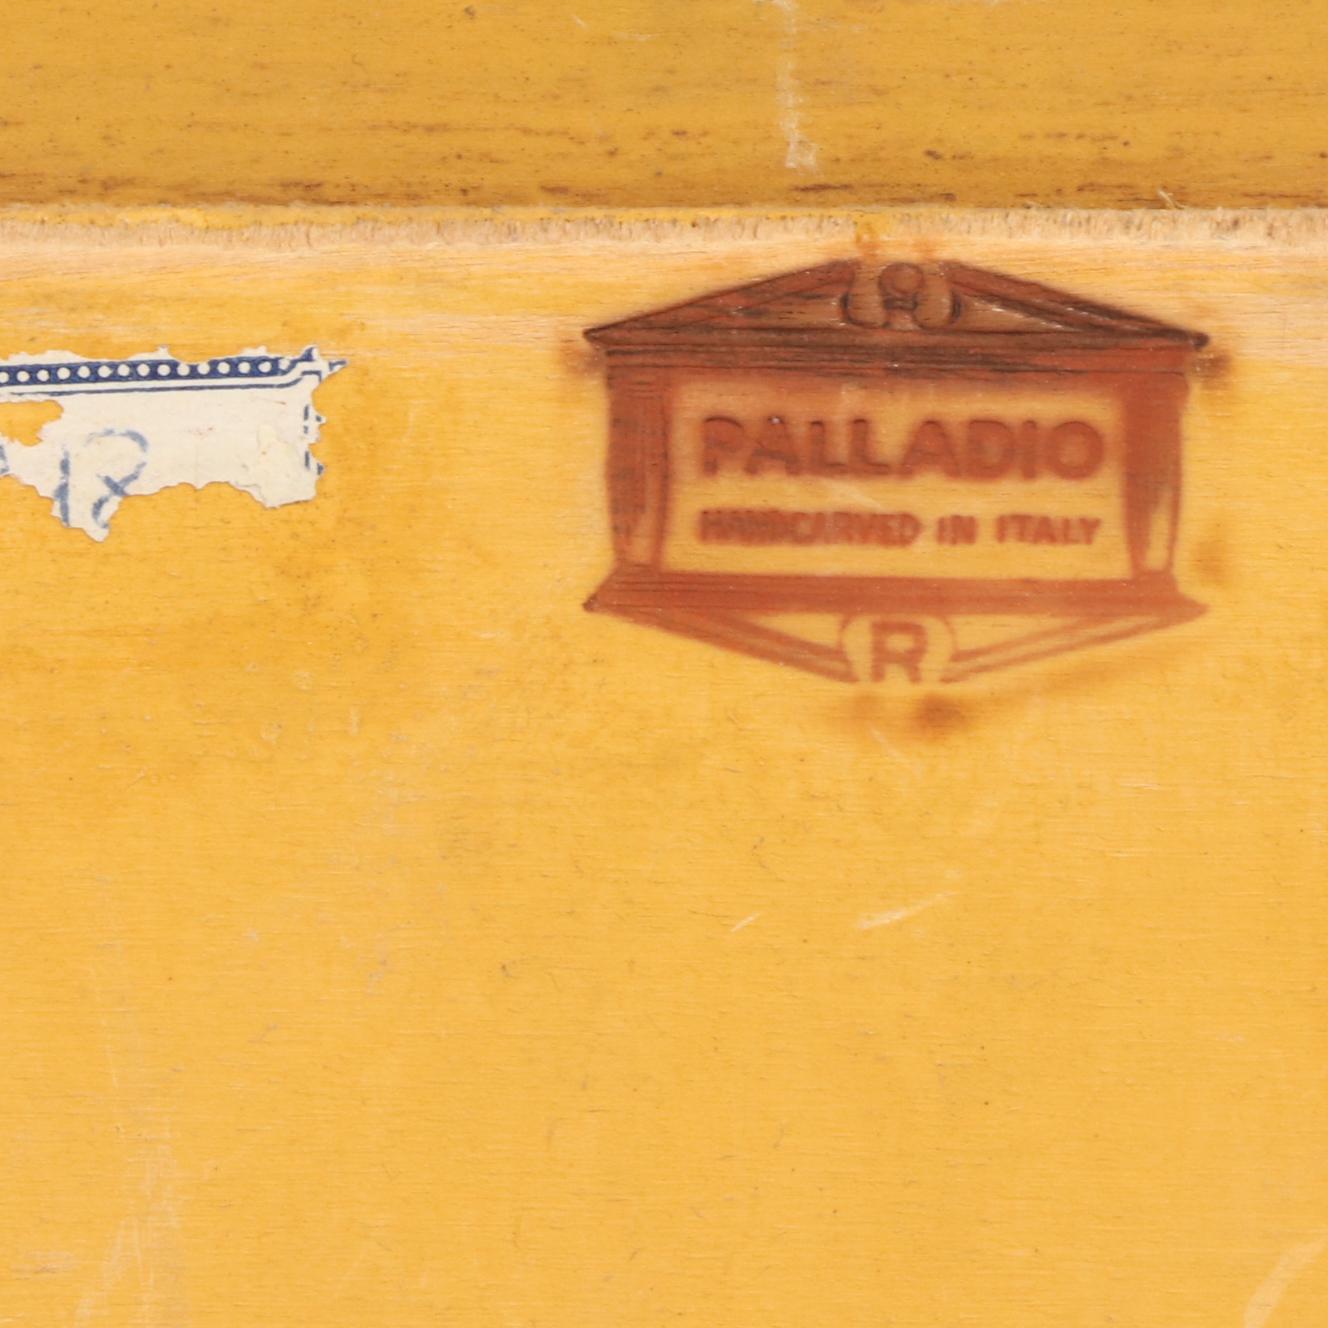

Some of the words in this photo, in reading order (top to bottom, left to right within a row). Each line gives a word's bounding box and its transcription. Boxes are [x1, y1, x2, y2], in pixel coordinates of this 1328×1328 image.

[701, 414, 1105, 481] PALLADIO
[936, 514, 979, 545] IN
[994, 513, 1102, 545] ITALY
[871, 621, 928, 684] R
